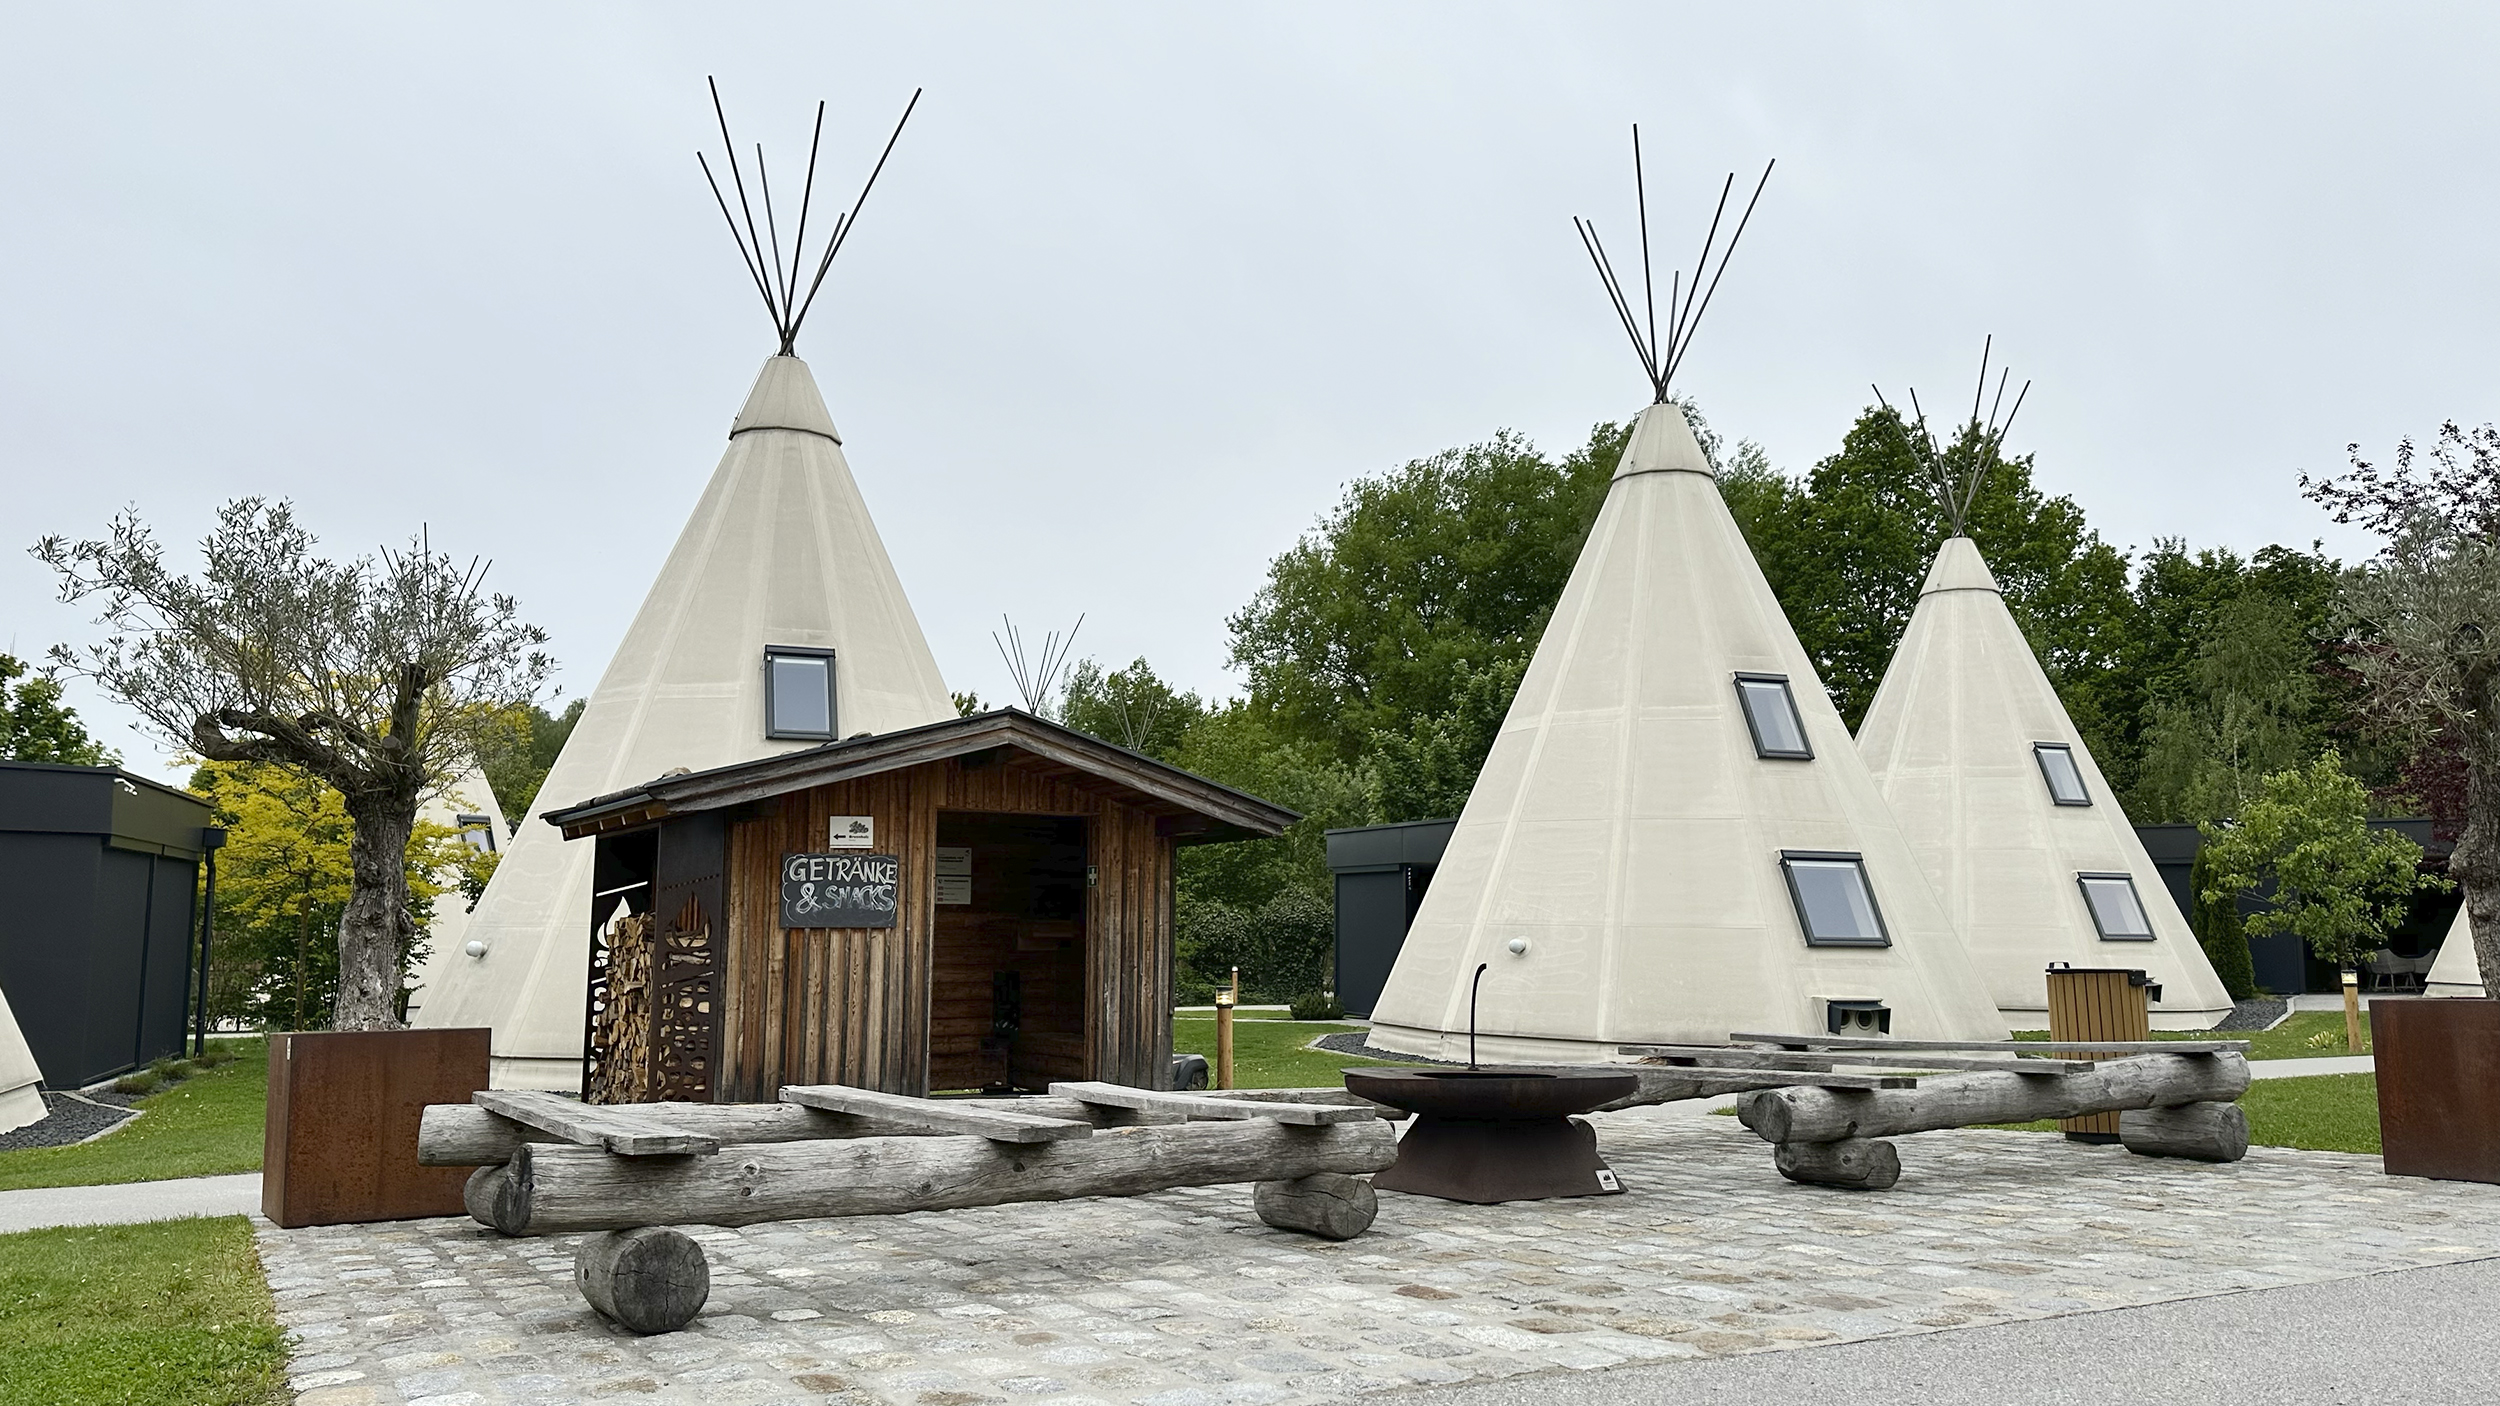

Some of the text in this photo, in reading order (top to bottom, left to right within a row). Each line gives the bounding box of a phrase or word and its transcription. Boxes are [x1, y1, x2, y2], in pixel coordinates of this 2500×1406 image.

[789, 857, 897, 884] GETRÄNKE
[796, 882, 894, 914] & SNACKS
